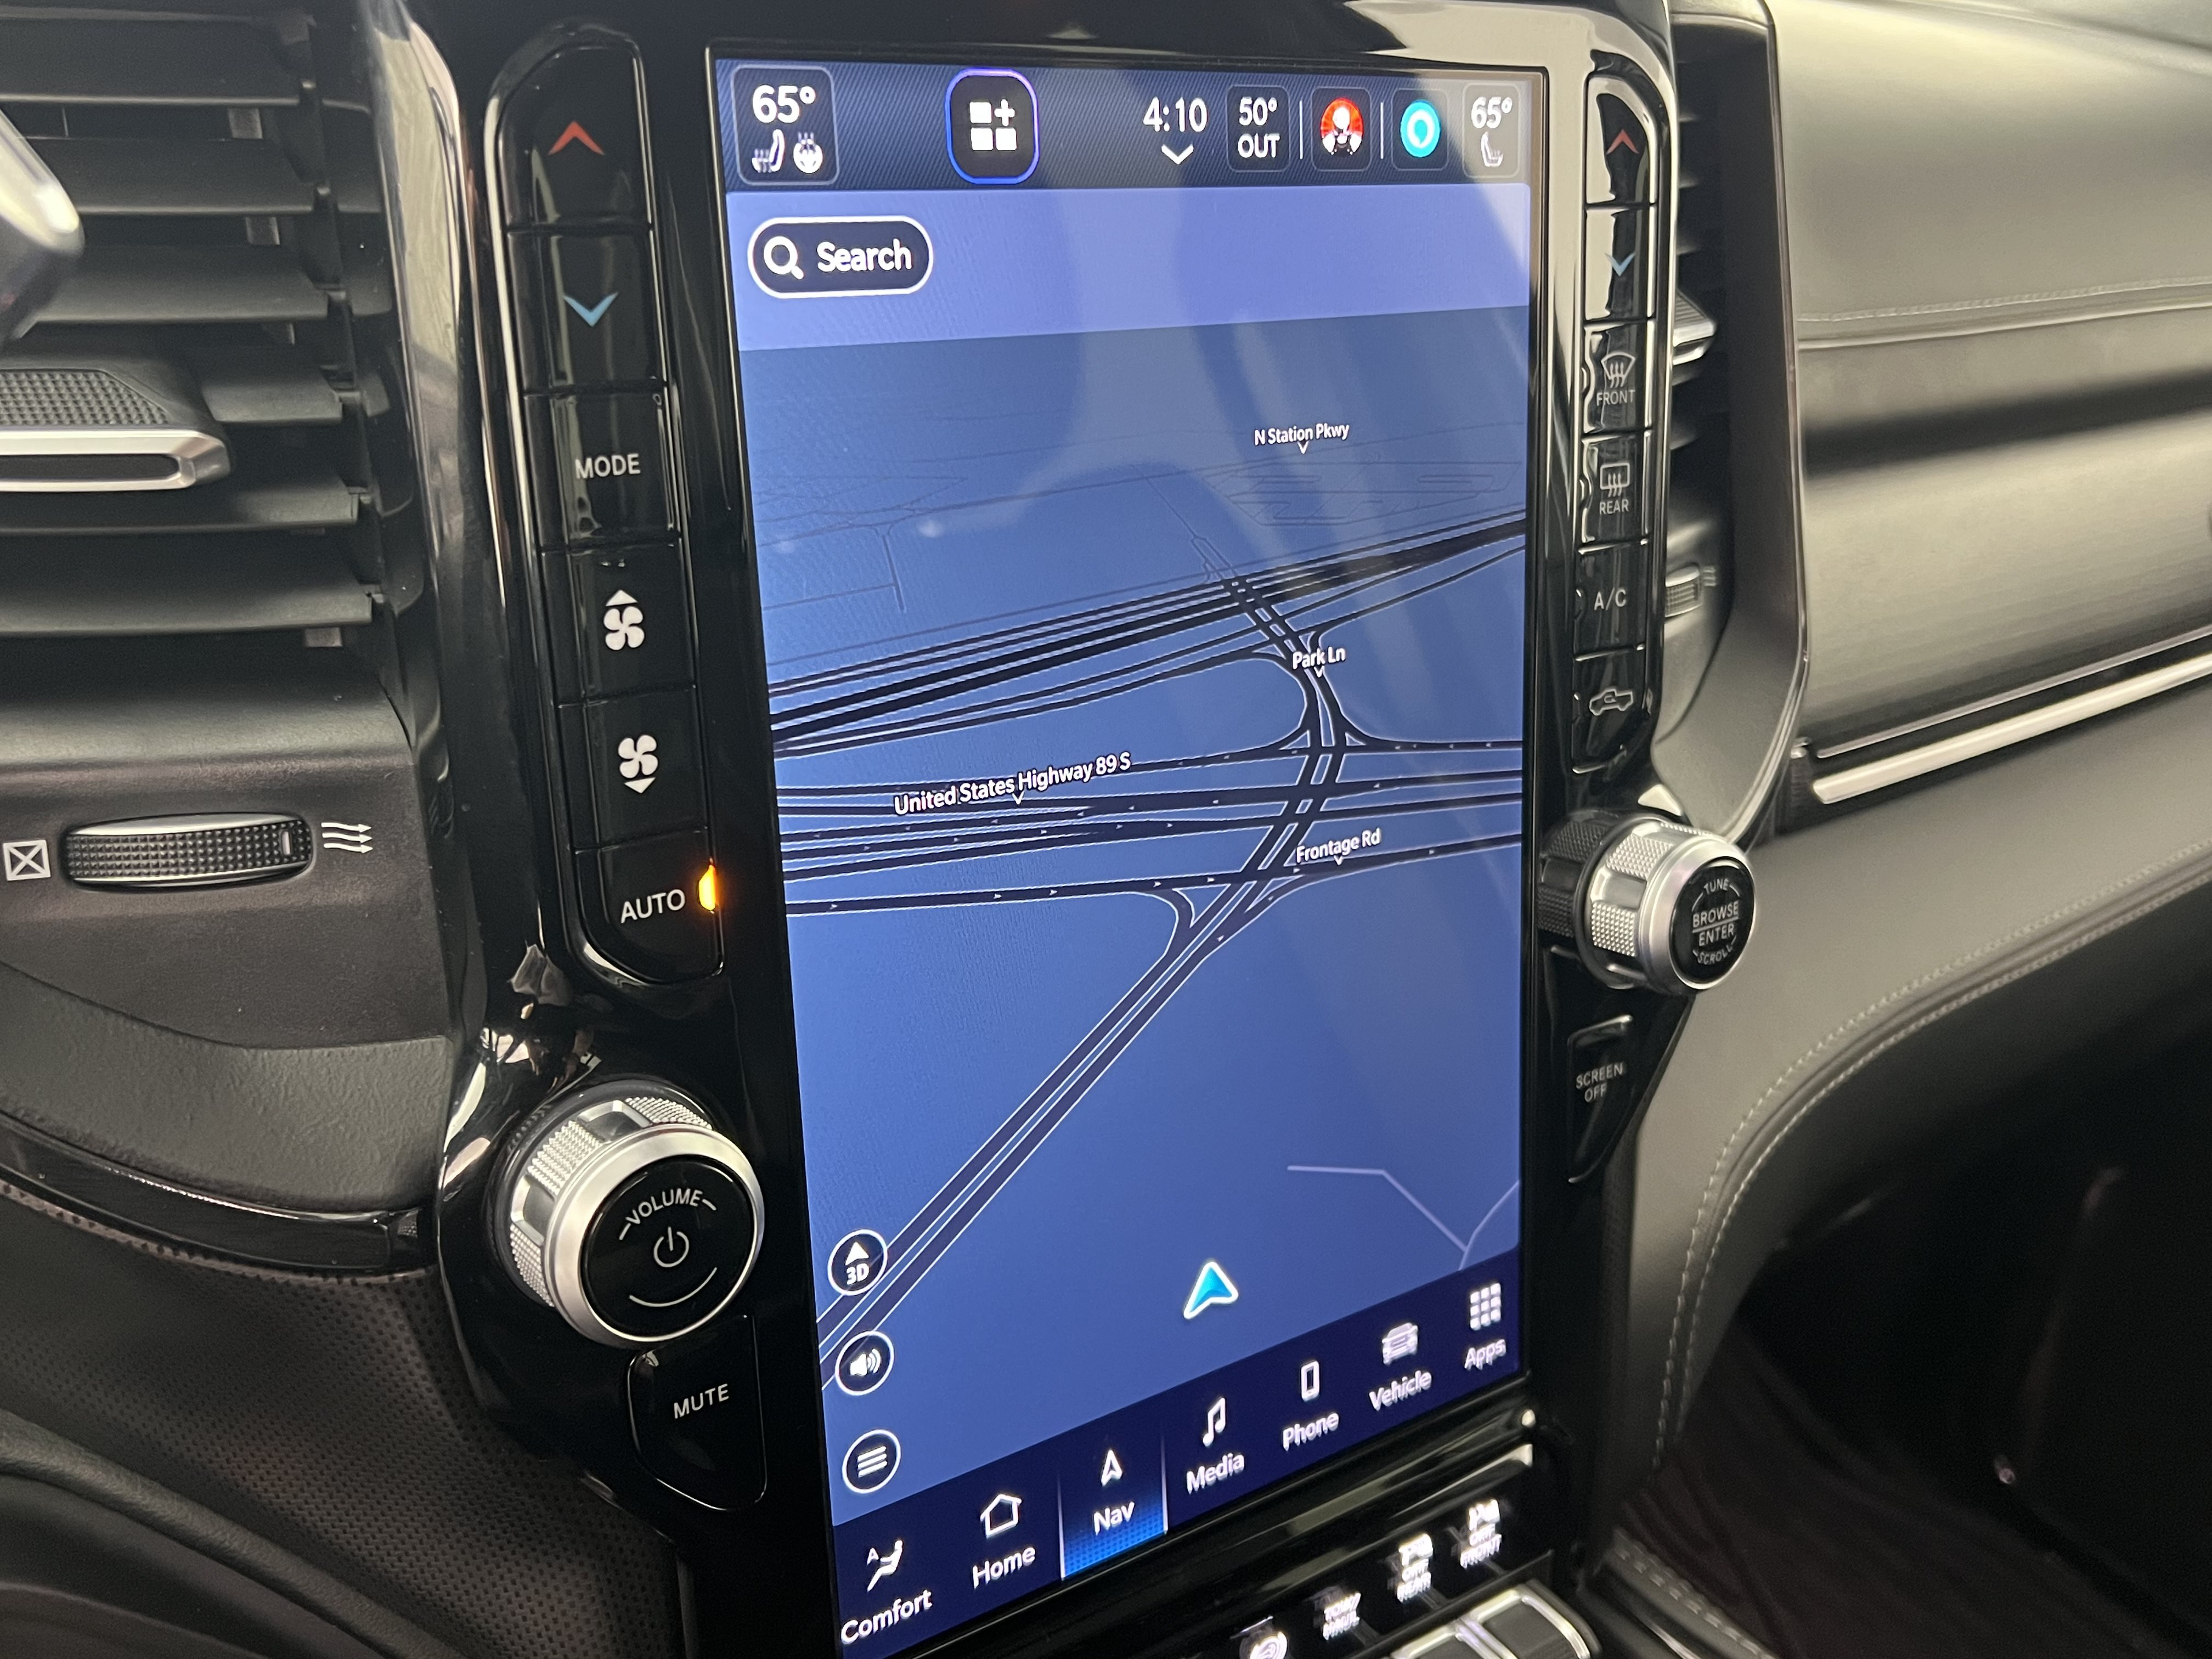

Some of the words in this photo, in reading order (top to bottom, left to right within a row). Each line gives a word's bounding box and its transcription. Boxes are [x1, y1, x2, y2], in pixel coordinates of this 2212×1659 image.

[1143, 97, 1207, 132] 4:10
[1237, 133, 1280, 159] OUT
[816, 239, 912, 273] Search
[1596, 389, 1636, 407] FRONT
[1254, 430, 1266, 445] N
[1268, 426, 1313, 444] Station
[1316, 423, 1350, 440] Pkwy
[575, 453, 641, 479] MODE
[1599, 499, 1629, 515] REAR
[1594, 587, 1627, 611] A/C
[1292, 648, 1325, 669] Park
[1328, 646, 1346, 663] Ln
[894, 786, 957, 815] United
[960, 777, 1015, 802] States
[1018, 763, 1093, 791] Highway
[1096, 757, 1118, 776] 89
[1119, 751, 1131, 770] S
[1296, 837, 1360, 864] Frontage
[1362, 827, 1381, 848] Rd
[1703, 878, 1728, 895] TUNE
[620, 889, 685, 923] AUTO
[1692, 900, 1739, 928] BROWSE
[1699, 923, 1734, 946] ENTER
[1697, 945, 1733, 965] SCROLL
[1576, 1062, 1623, 1089] SCREEN
[1584, 1082, 1607, 1103] OFF
[625, 1188, 703, 1224] VOLUME
[846, 1263, 870, 1285] 3D
[1464, 1339, 1506, 1369] Apps
[673, 1383, 729, 1419] MUTE
[1369, 1370, 1431, 1410] Vehicle
[1283, 1413, 1339, 1451] Phone
[1186, 1453, 1244, 1494] Media
[1093, 1502, 1135, 1536] Nav
[973, 1547, 1036, 1589] Home
[840, 1589, 933, 1644] Comfort
